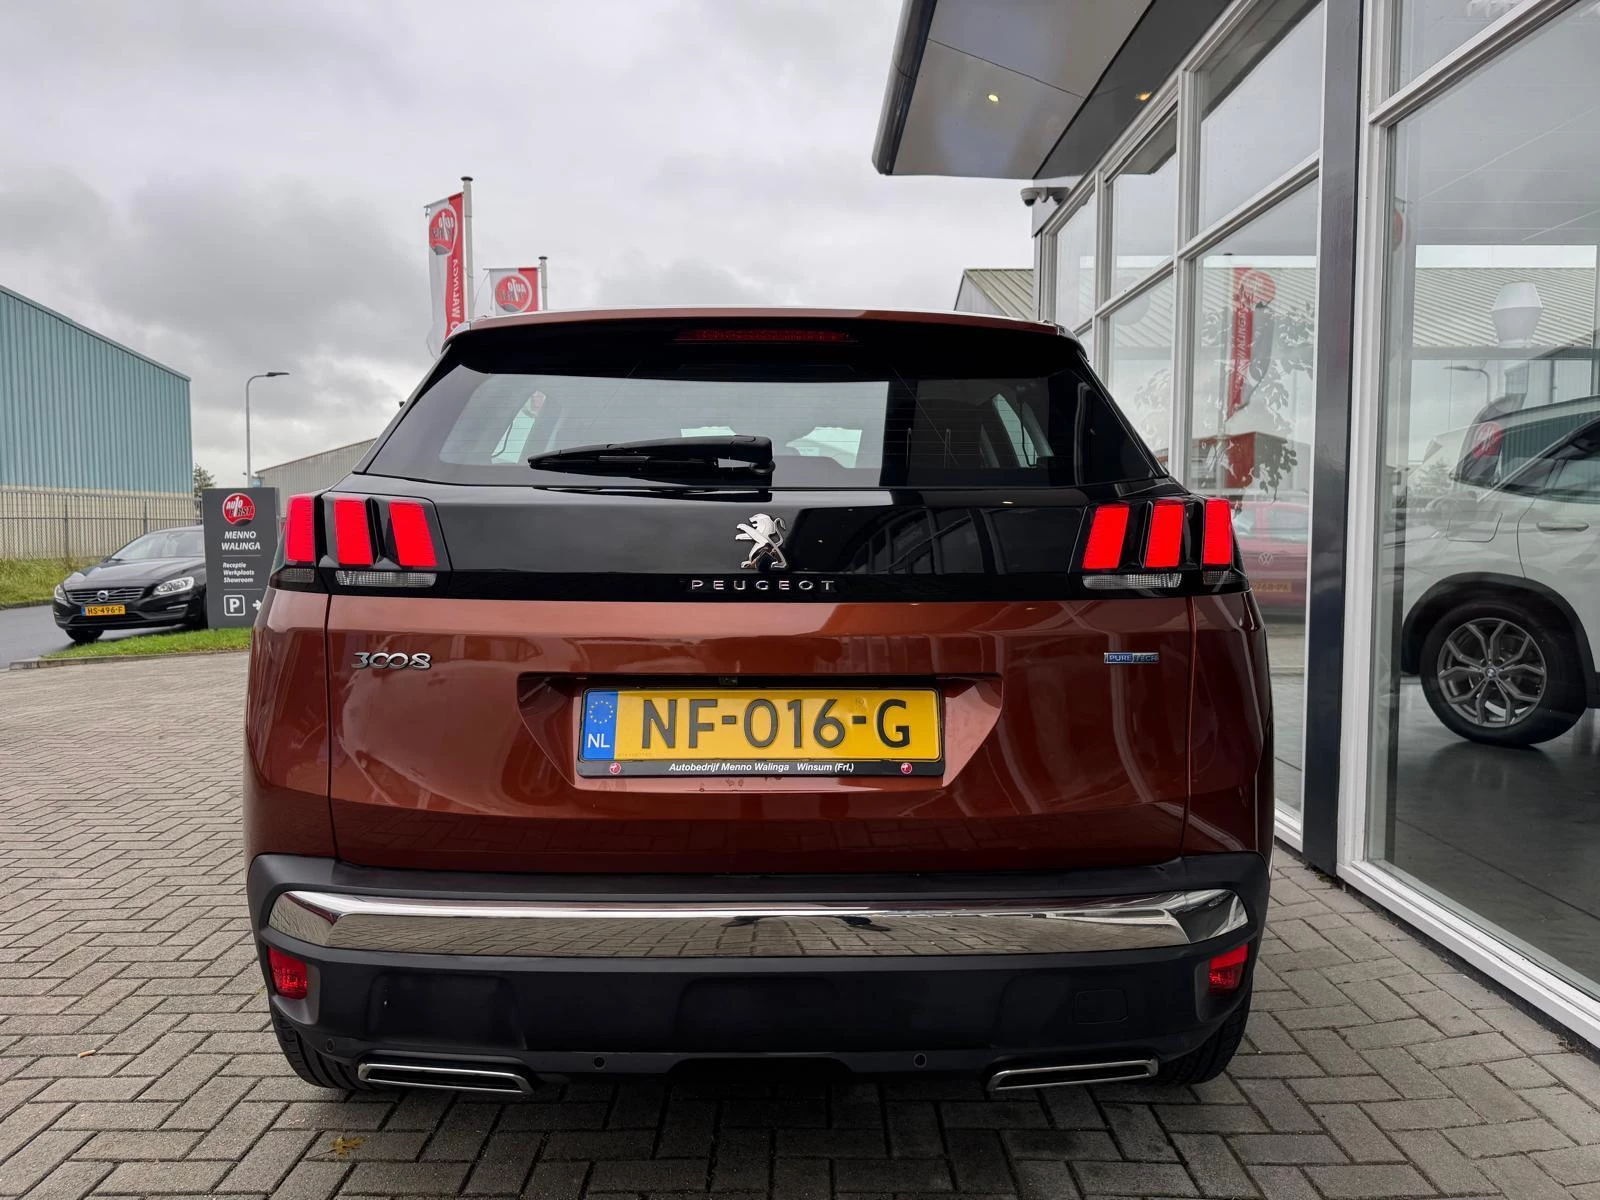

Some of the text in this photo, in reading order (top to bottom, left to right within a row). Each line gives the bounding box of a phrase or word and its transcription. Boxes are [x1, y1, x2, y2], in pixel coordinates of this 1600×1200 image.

[224, 531, 257, 539] MENNO
[221, 542, 261, 550] WALINGA
[691, 579, 835, 590] PEUGEOT
[87, 606, 124, 615] HS-496-F
[229, 598, 240, 613] P
[351, 651, 432, 669] 3008
[641, 698, 912, 749] NF-016-G
[587, 733, 610, 749] NL
[669, 762, 720, 773] Autobedrijf
[721, 762, 753, 772] Menno
[754, 762, 790, 773] Walinga
[796, 762, 833, 772] Winsum
